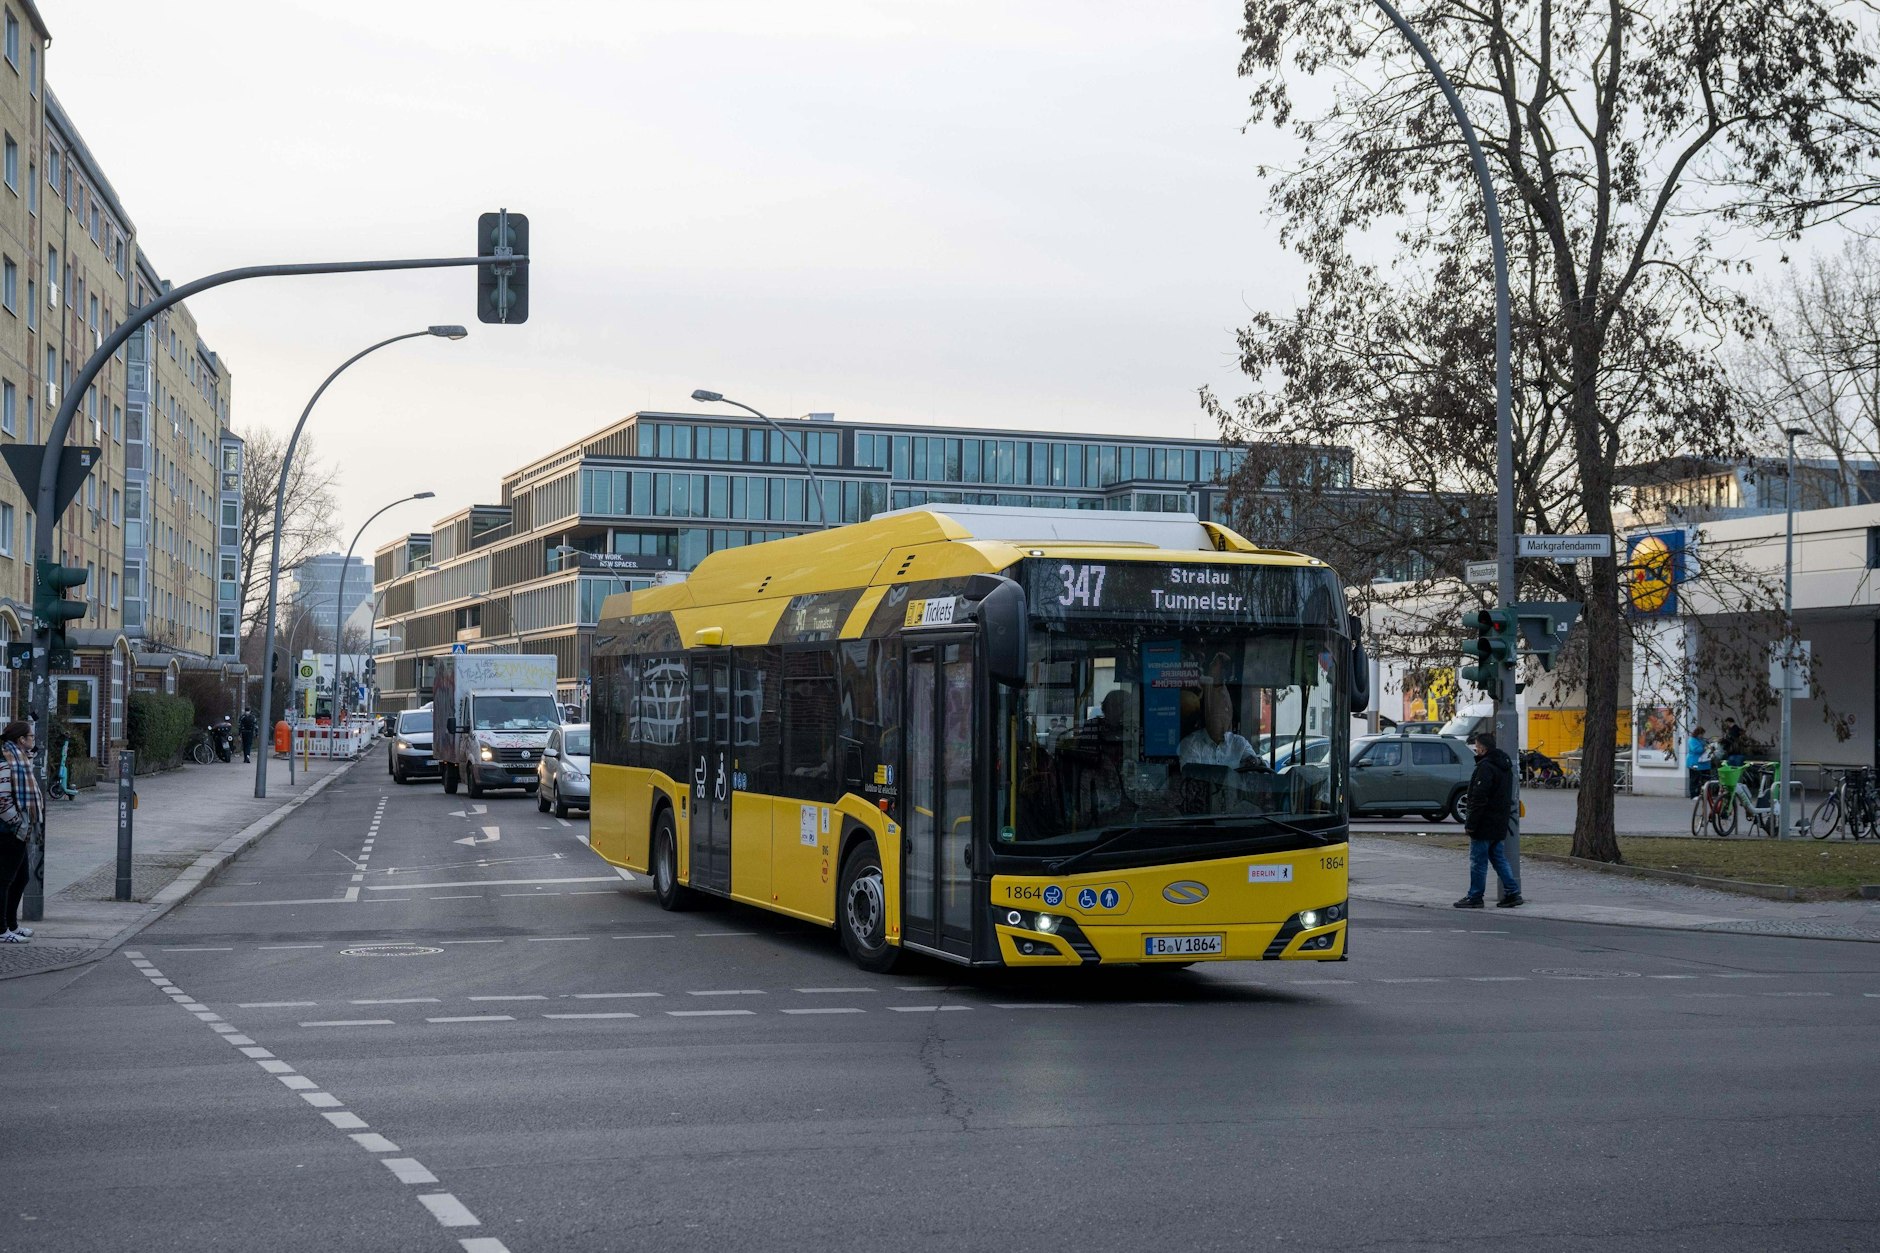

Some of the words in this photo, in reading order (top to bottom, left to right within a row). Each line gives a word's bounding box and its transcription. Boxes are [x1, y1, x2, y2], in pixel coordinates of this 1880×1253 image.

[1527, 541, 1601, 552] Markgrafendamm
[604, 553, 624, 561] WORK.
[1171, 568, 1230, 585] Stralau
[1058, 565, 1106, 607] 347
[1151, 590, 1247, 611] Tunnelstr.
[925, 602, 952, 622] Tickets
[1319, 856, 1344, 870] 1864
[1006, 886, 1041, 899] 1864
[1158, 939, 1166, 952] B
[1174, 939, 1182, 951] V
[1186, 938, 1216, 951] 1864
